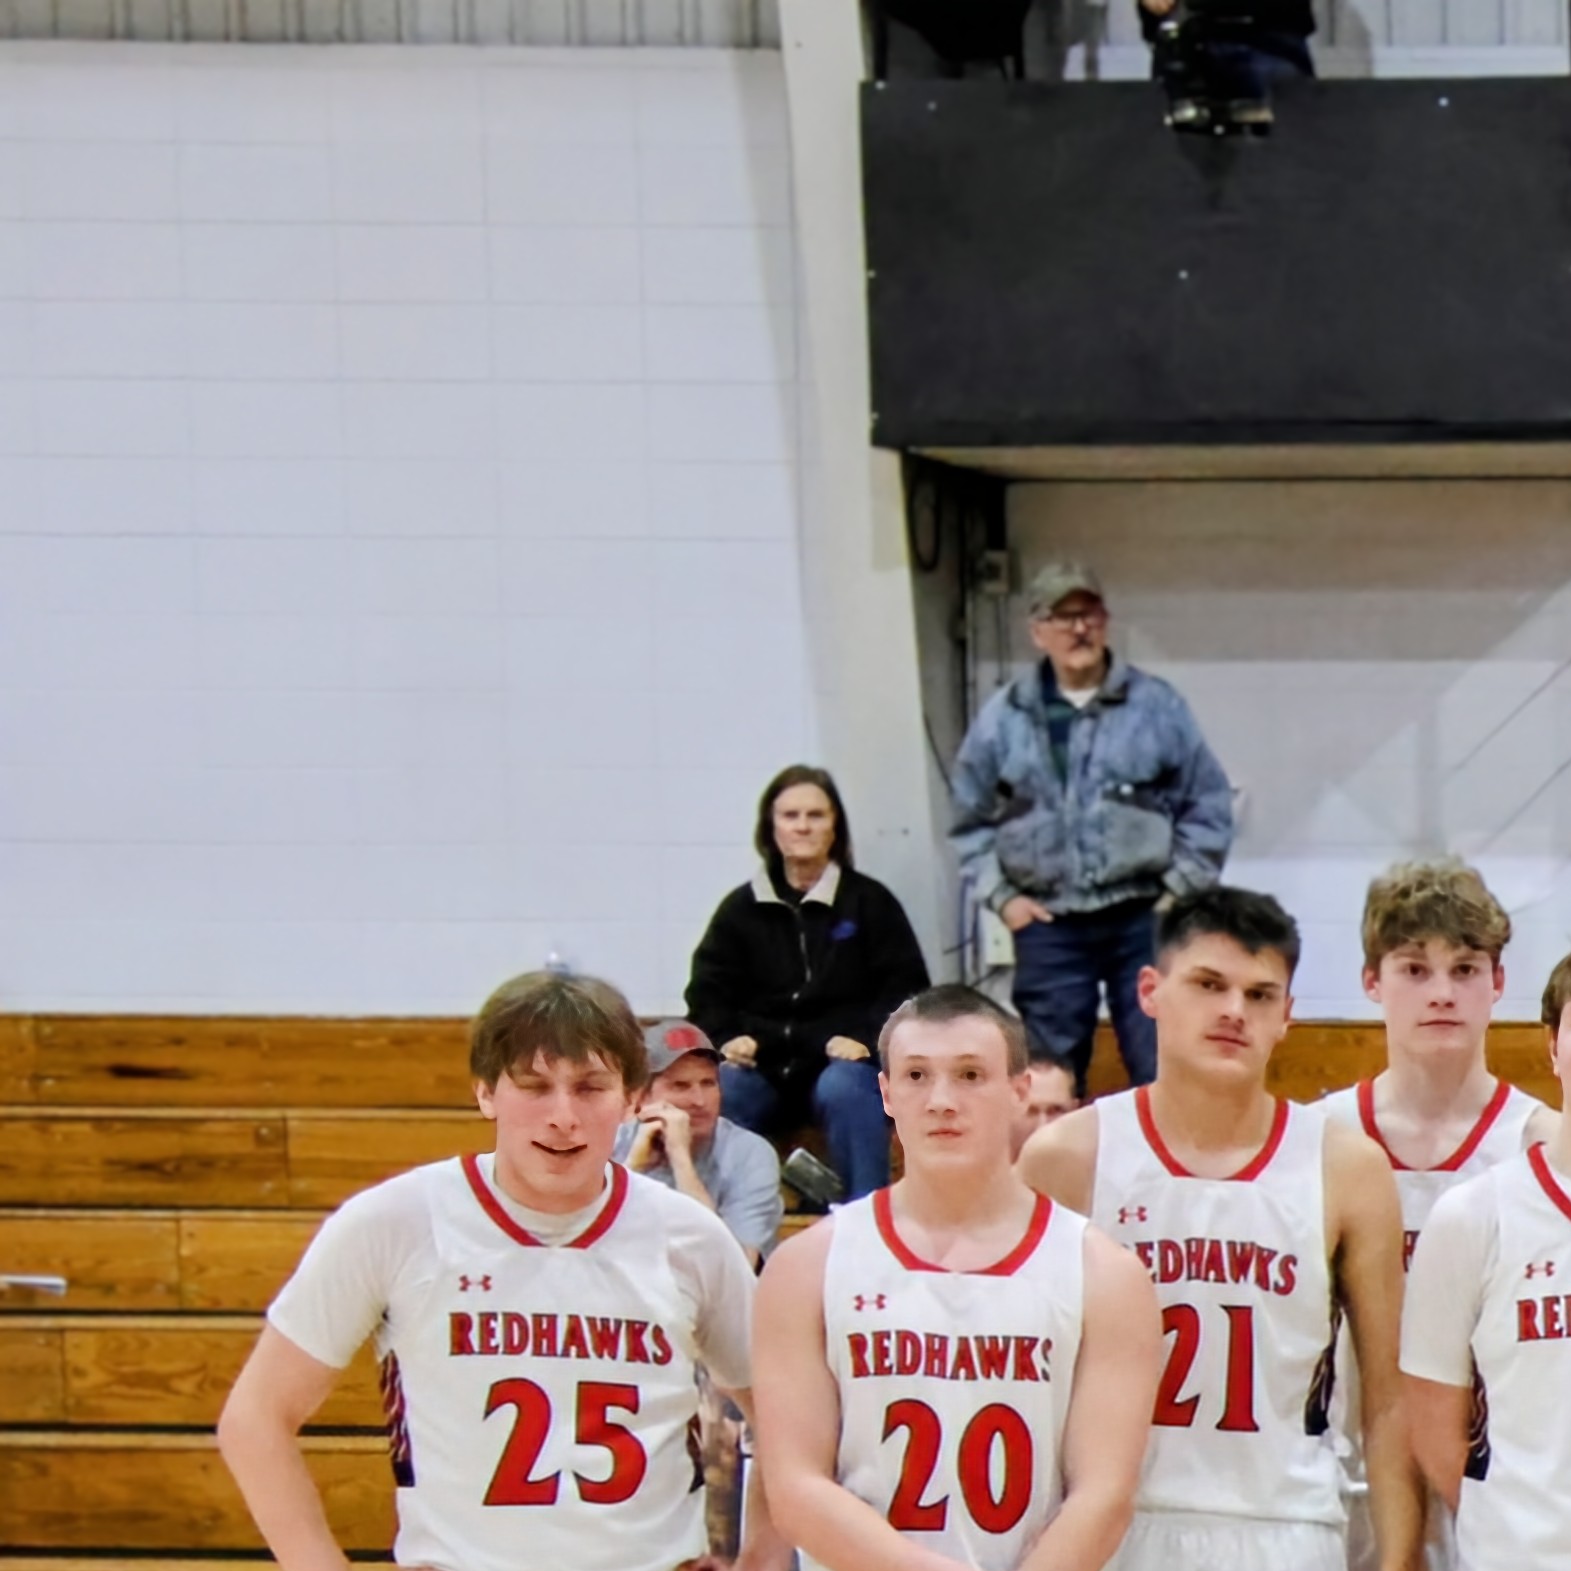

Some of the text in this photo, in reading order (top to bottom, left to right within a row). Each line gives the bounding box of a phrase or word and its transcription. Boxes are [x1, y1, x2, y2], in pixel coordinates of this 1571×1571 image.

[1122, 1237, 1298, 1296] EDHAWKS
[448, 1311, 674, 1366] REDHAWKS
[847, 1329, 1050, 1383] REDHAWKS
[1150, 1302, 1260, 1433] 21
[482, 1377, 649, 1507] 25
[881, 1398, 1036, 1535] 20
